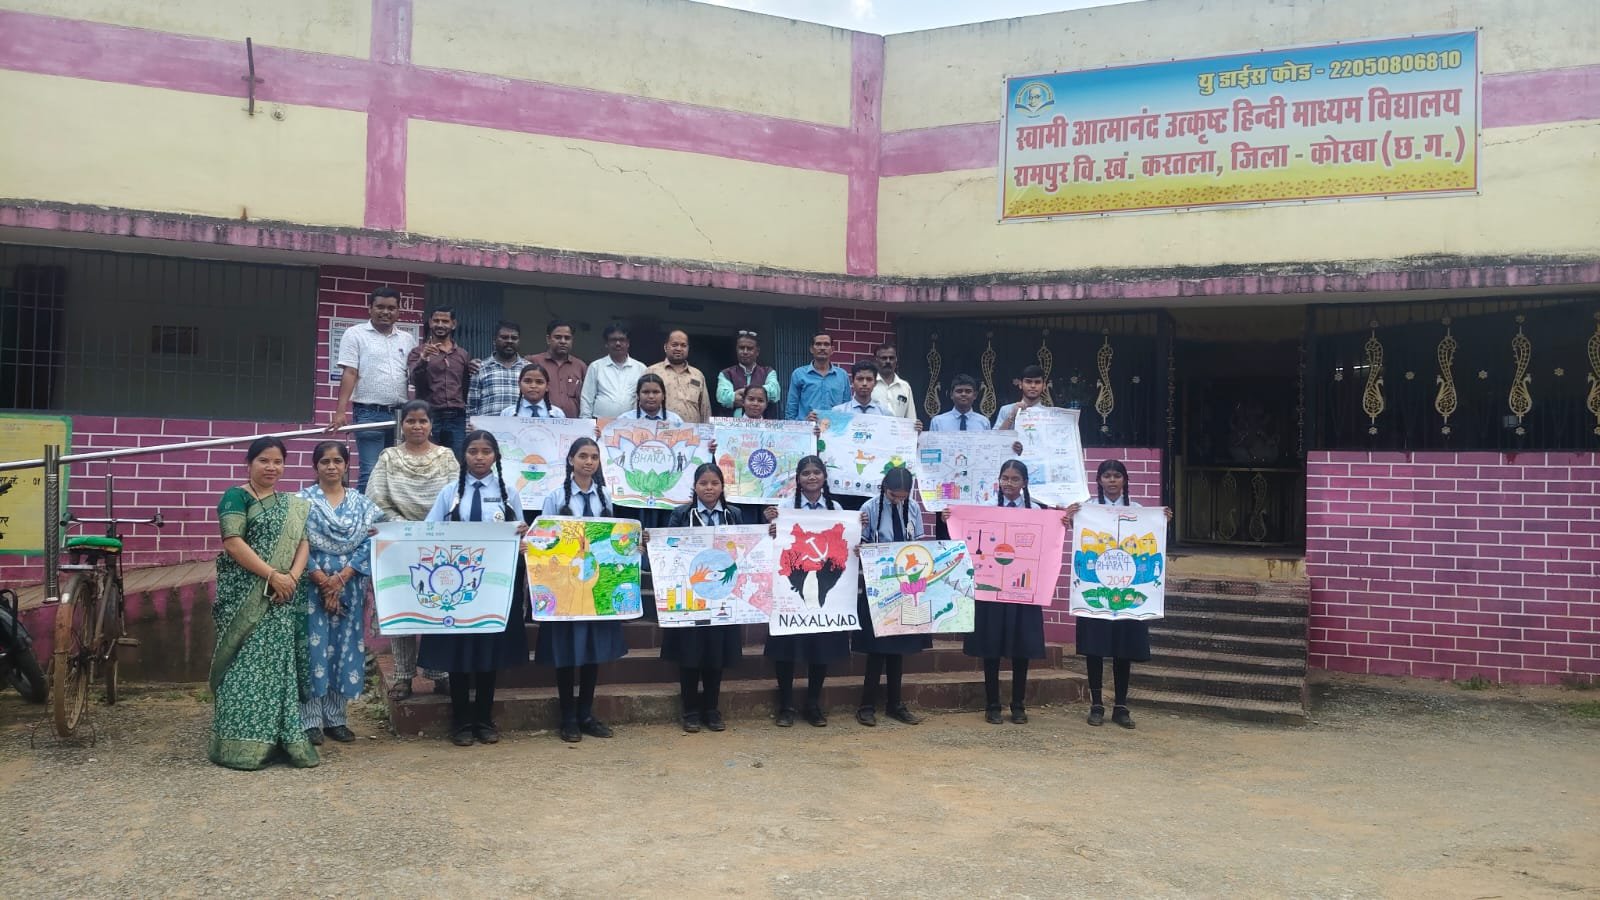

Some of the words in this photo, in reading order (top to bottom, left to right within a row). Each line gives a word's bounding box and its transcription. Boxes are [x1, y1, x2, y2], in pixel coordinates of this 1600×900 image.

[1271, 60, 1313, 84] कोड
[1328, 50, 1462, 79] 22050806810
[1015, 115, 1069, 151] स्वामी
[1072, 108, 1162, 147] आत्मानंद
[1165, 107, 1229, 145] उत्कृष्ट
[1233, 95, 1287, 133] हिन्दी
[1292, 96, 1364, 128] माध्यम
[1368, 87, 1463, 122] विद्यालय
[1014, 162, 1070, 193] रामपुर
[1141, 150, 1224, 177] करतला,
[1230, 141, 1290, 171] जिला
[1309, 134, 1378, 165] कोरबा
[633, 452, 673, 464] BHARAT
[1096, 560, 1133, 571] BHARAT
[1106, 575, 1133, 586] 2047
[778, 613, 857, 628] NAXALWAD
